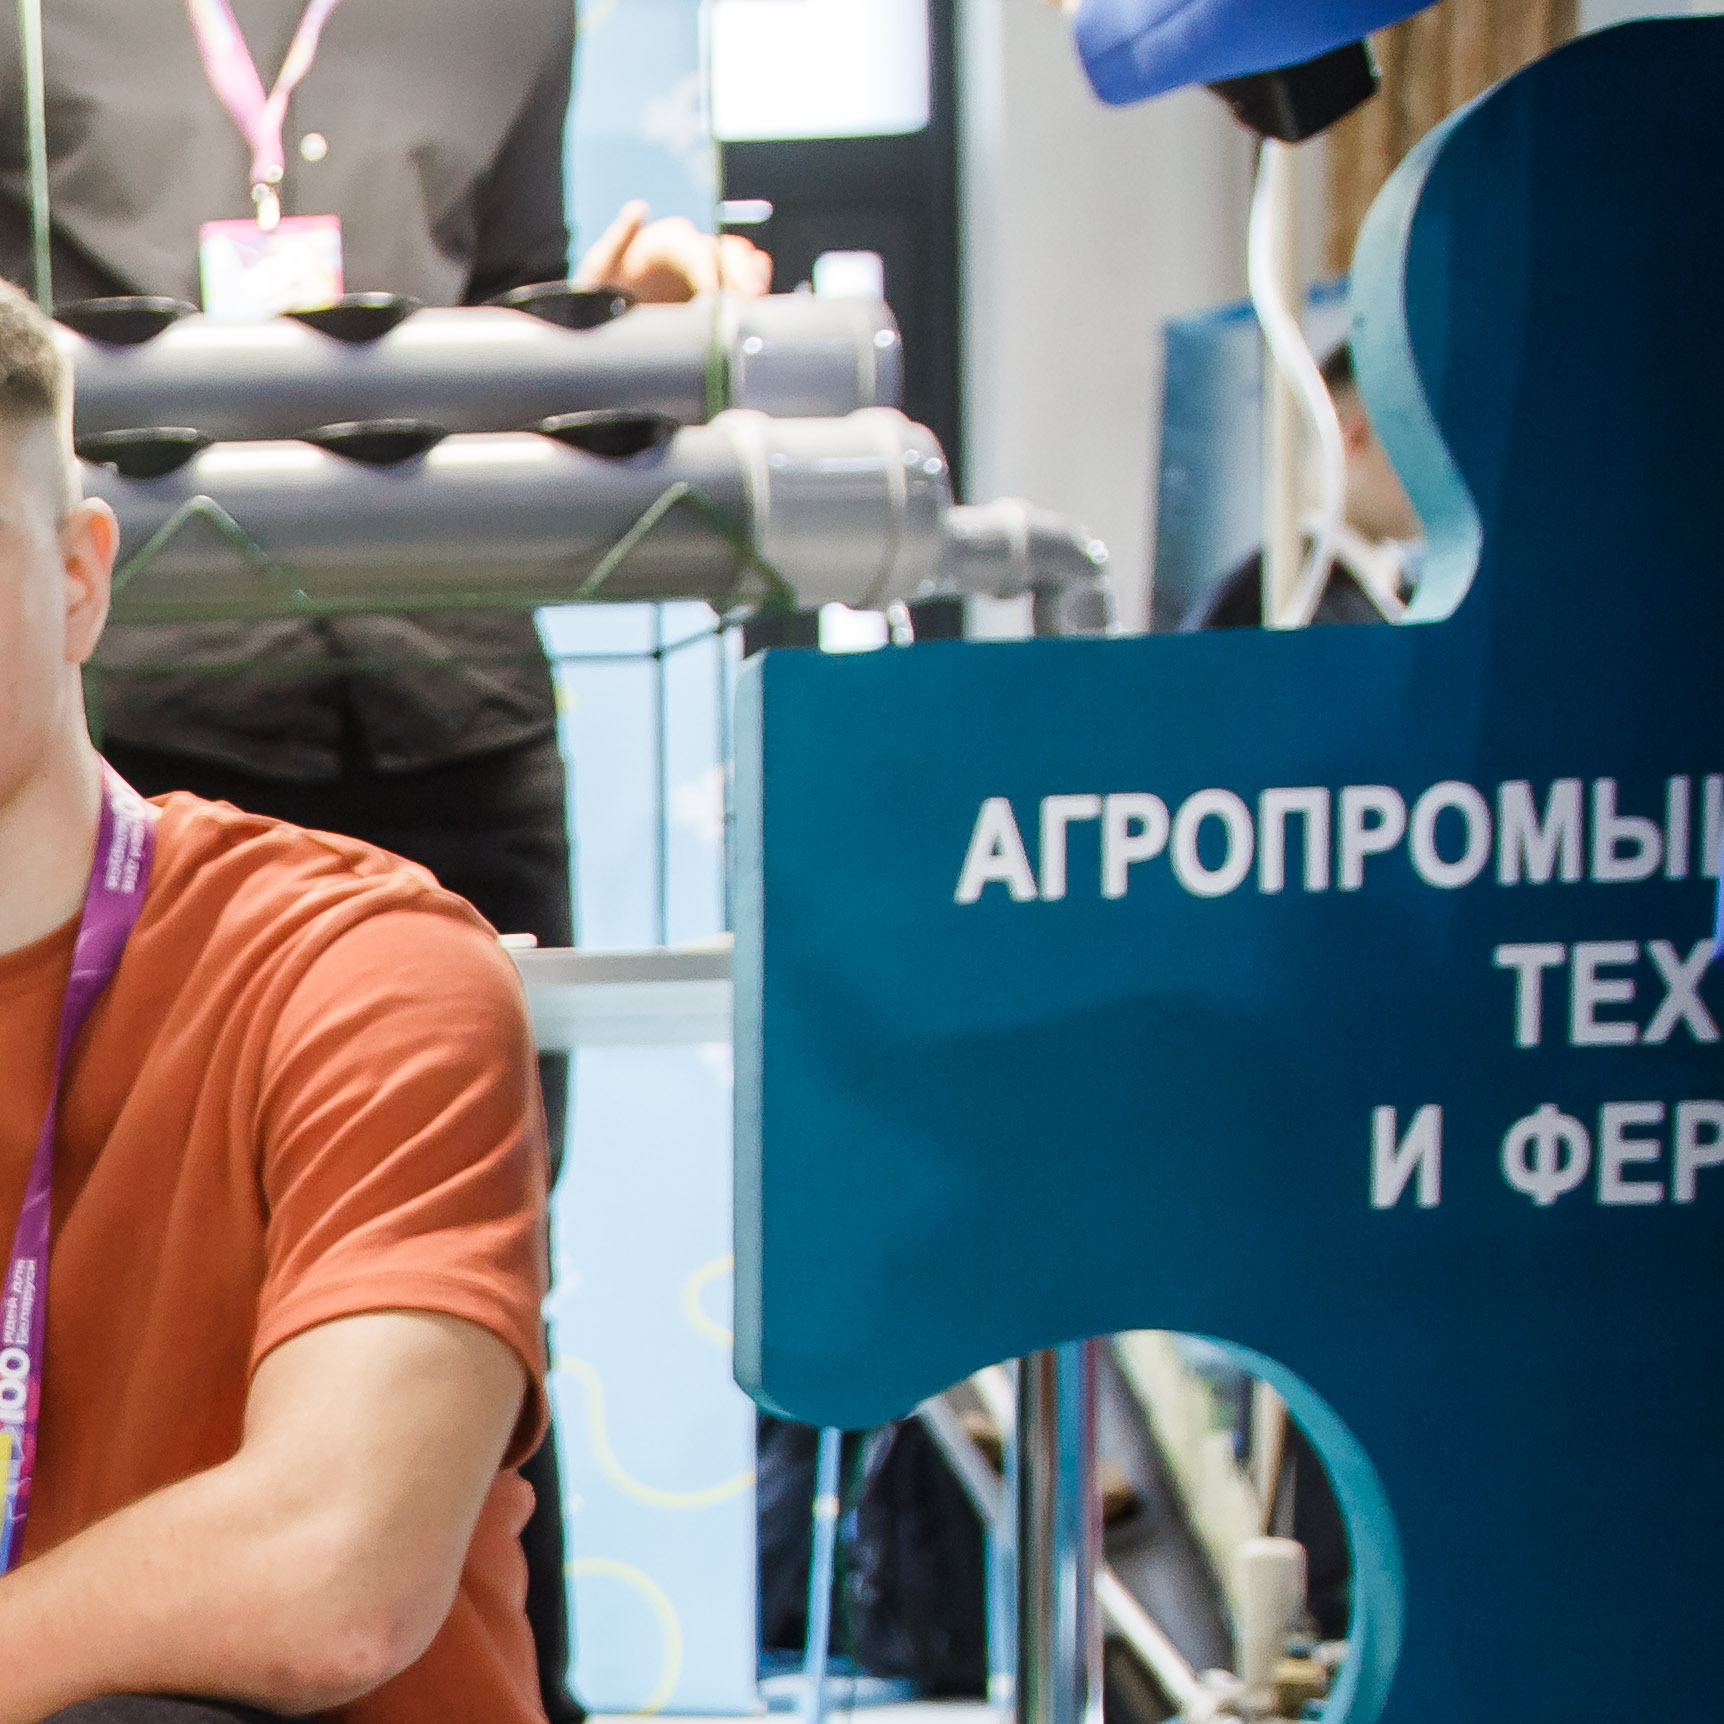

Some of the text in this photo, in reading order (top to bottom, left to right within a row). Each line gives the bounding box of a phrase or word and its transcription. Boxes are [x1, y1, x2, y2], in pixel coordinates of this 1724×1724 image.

[954, 776, 1724, 905] АГРОПРОМЫ
[1494, 939, 1724, 1048] ТЕХ
[1370, 1101, 1724, 1209] И ФЕР
